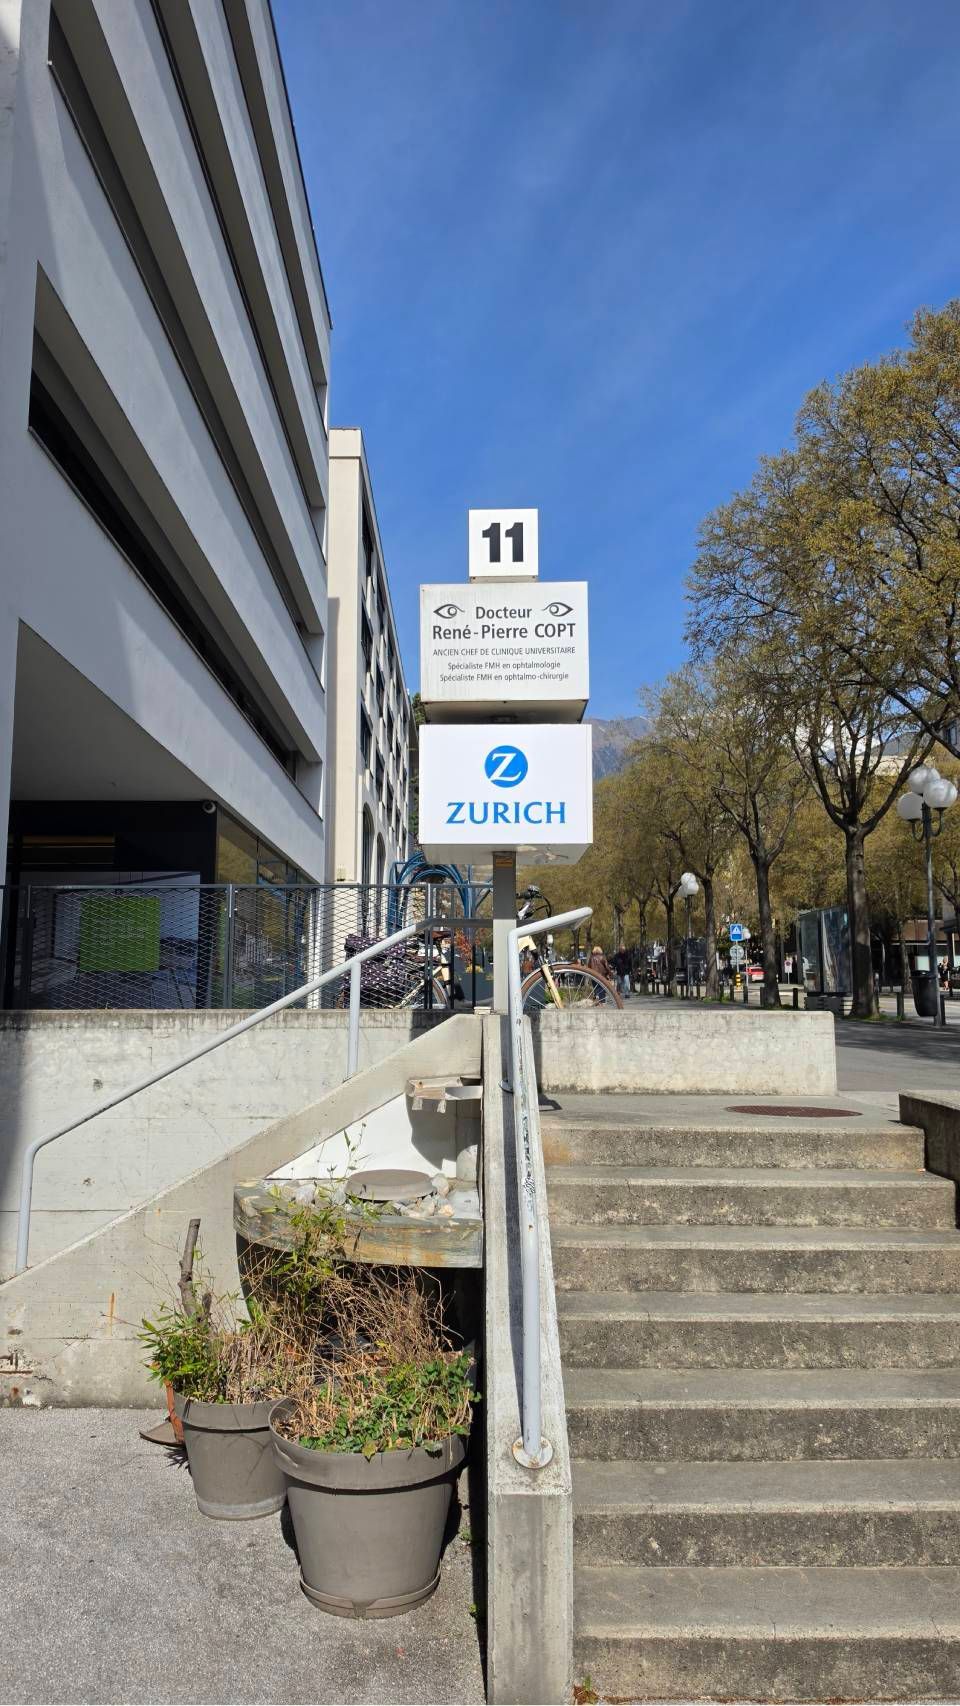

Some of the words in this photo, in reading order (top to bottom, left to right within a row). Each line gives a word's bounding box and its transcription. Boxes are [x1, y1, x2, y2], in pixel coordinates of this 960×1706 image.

[482, 522, 524, 563] 11
[475, 606, 533, 620] Docteur
[534, 623, 576, 638] COPT
[433, 648, 459, 656] ANCIEN
[491, 648, 523, 656] CLINIQUE
[525, 646, 576, 655] UNIVERSITAIRE
[448, 662, 483, 671] Spécialiste
[512, 661, 560, 670] ophtalmologie
[440, 673, 474, 682] Spécialiste
[489, 752, 522, 782] Z
[446, 801, 566, 825] ZURICH
